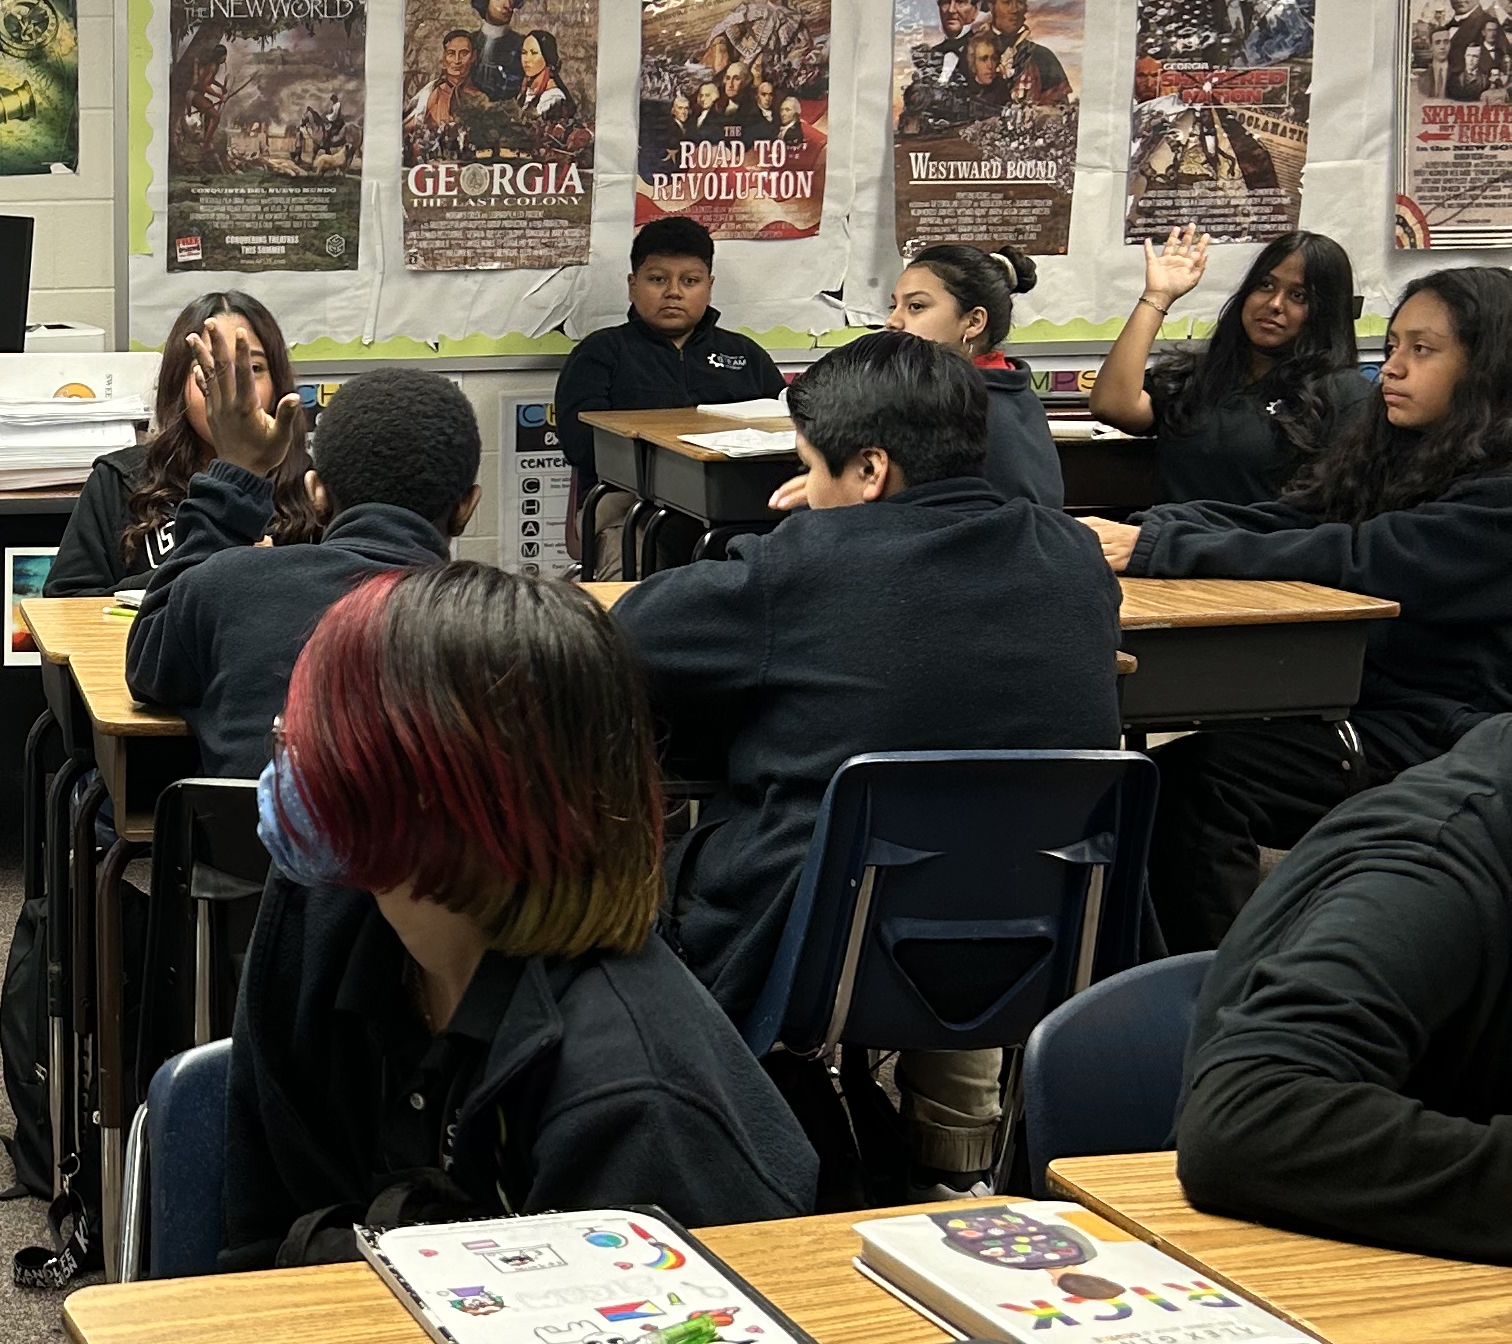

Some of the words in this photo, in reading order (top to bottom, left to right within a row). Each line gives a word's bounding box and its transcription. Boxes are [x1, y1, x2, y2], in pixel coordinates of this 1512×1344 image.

[723, 125, 742, 138] THE
[1458, 124, 1512, 144] EQUA
[679, 140, 745, 169] ROAD
[754, 139, 787, 168] TO
[407, 162, 586, 197] GEORGIA
[1006, 160, 1058, 180] BOUND
[652, 171, 814, 201] REVOLUTION
[410, 198, 447, 208] THE
[452, 197, 500, 207] LAST
[503, 196, 583, 206] COLONY
[997, 1280, 1242, 1331] RICK
[1182, 1325, 1255, 1344] ALEX
